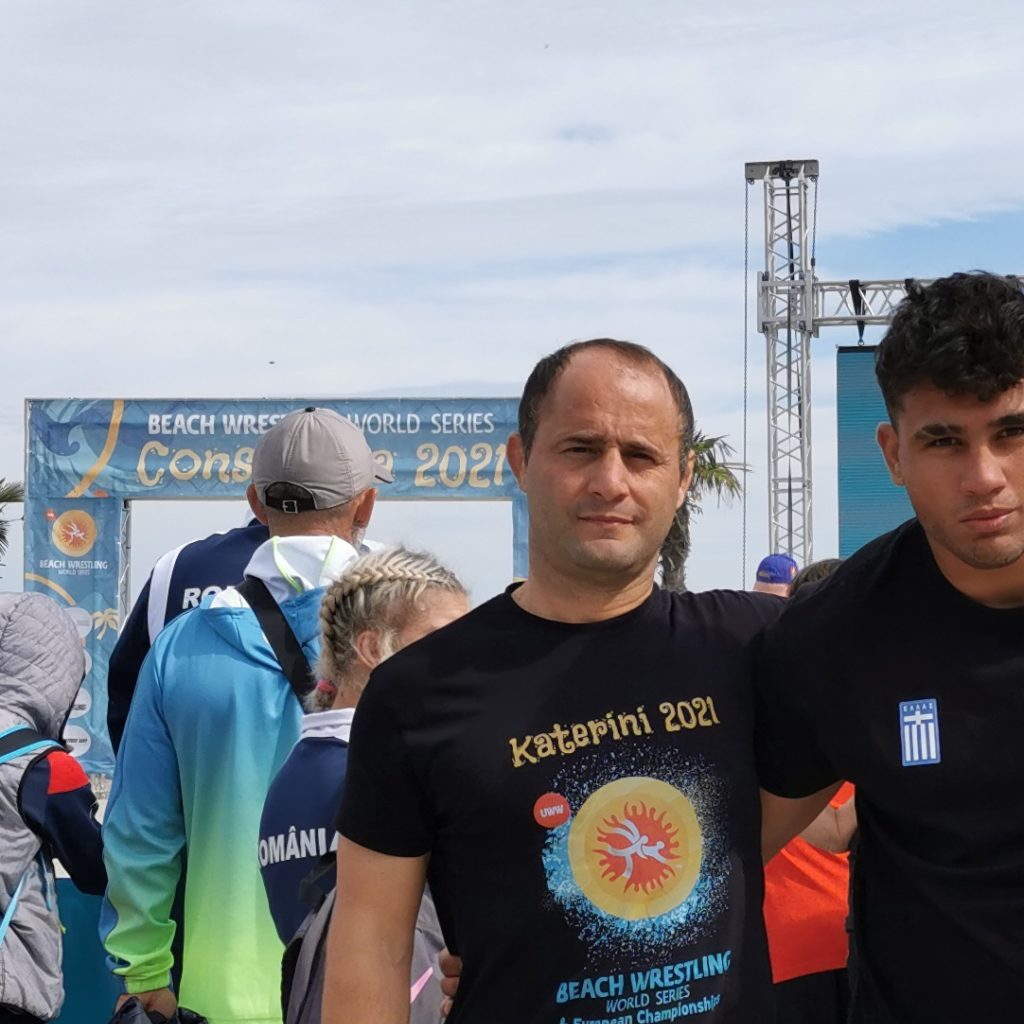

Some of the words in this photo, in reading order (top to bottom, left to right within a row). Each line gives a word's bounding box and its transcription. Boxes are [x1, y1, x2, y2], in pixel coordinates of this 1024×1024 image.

[148, 414, 215, 435] BEACH
[222, 413, 286, 435] WRES
[431, 413, 494, 434] SERIES
[414, 443, 508, 488] 2021
[40, 560, 65, 569] BEACH
[67, 560, 108, 569] WRESTLING
[509, 705, 654, 768] Katerini
[658, 696, 720, 732] 2021
[540, 804, 564, 818] UWW
[259, 825, 339, 867] OMÂNI
[556, 974, 624, 1003] BEACH
[630, 950, 732, 993] WRESTLING
[606, 993, 650, 1013] WORLD
[655, 984, 691, 1005] SERIES
